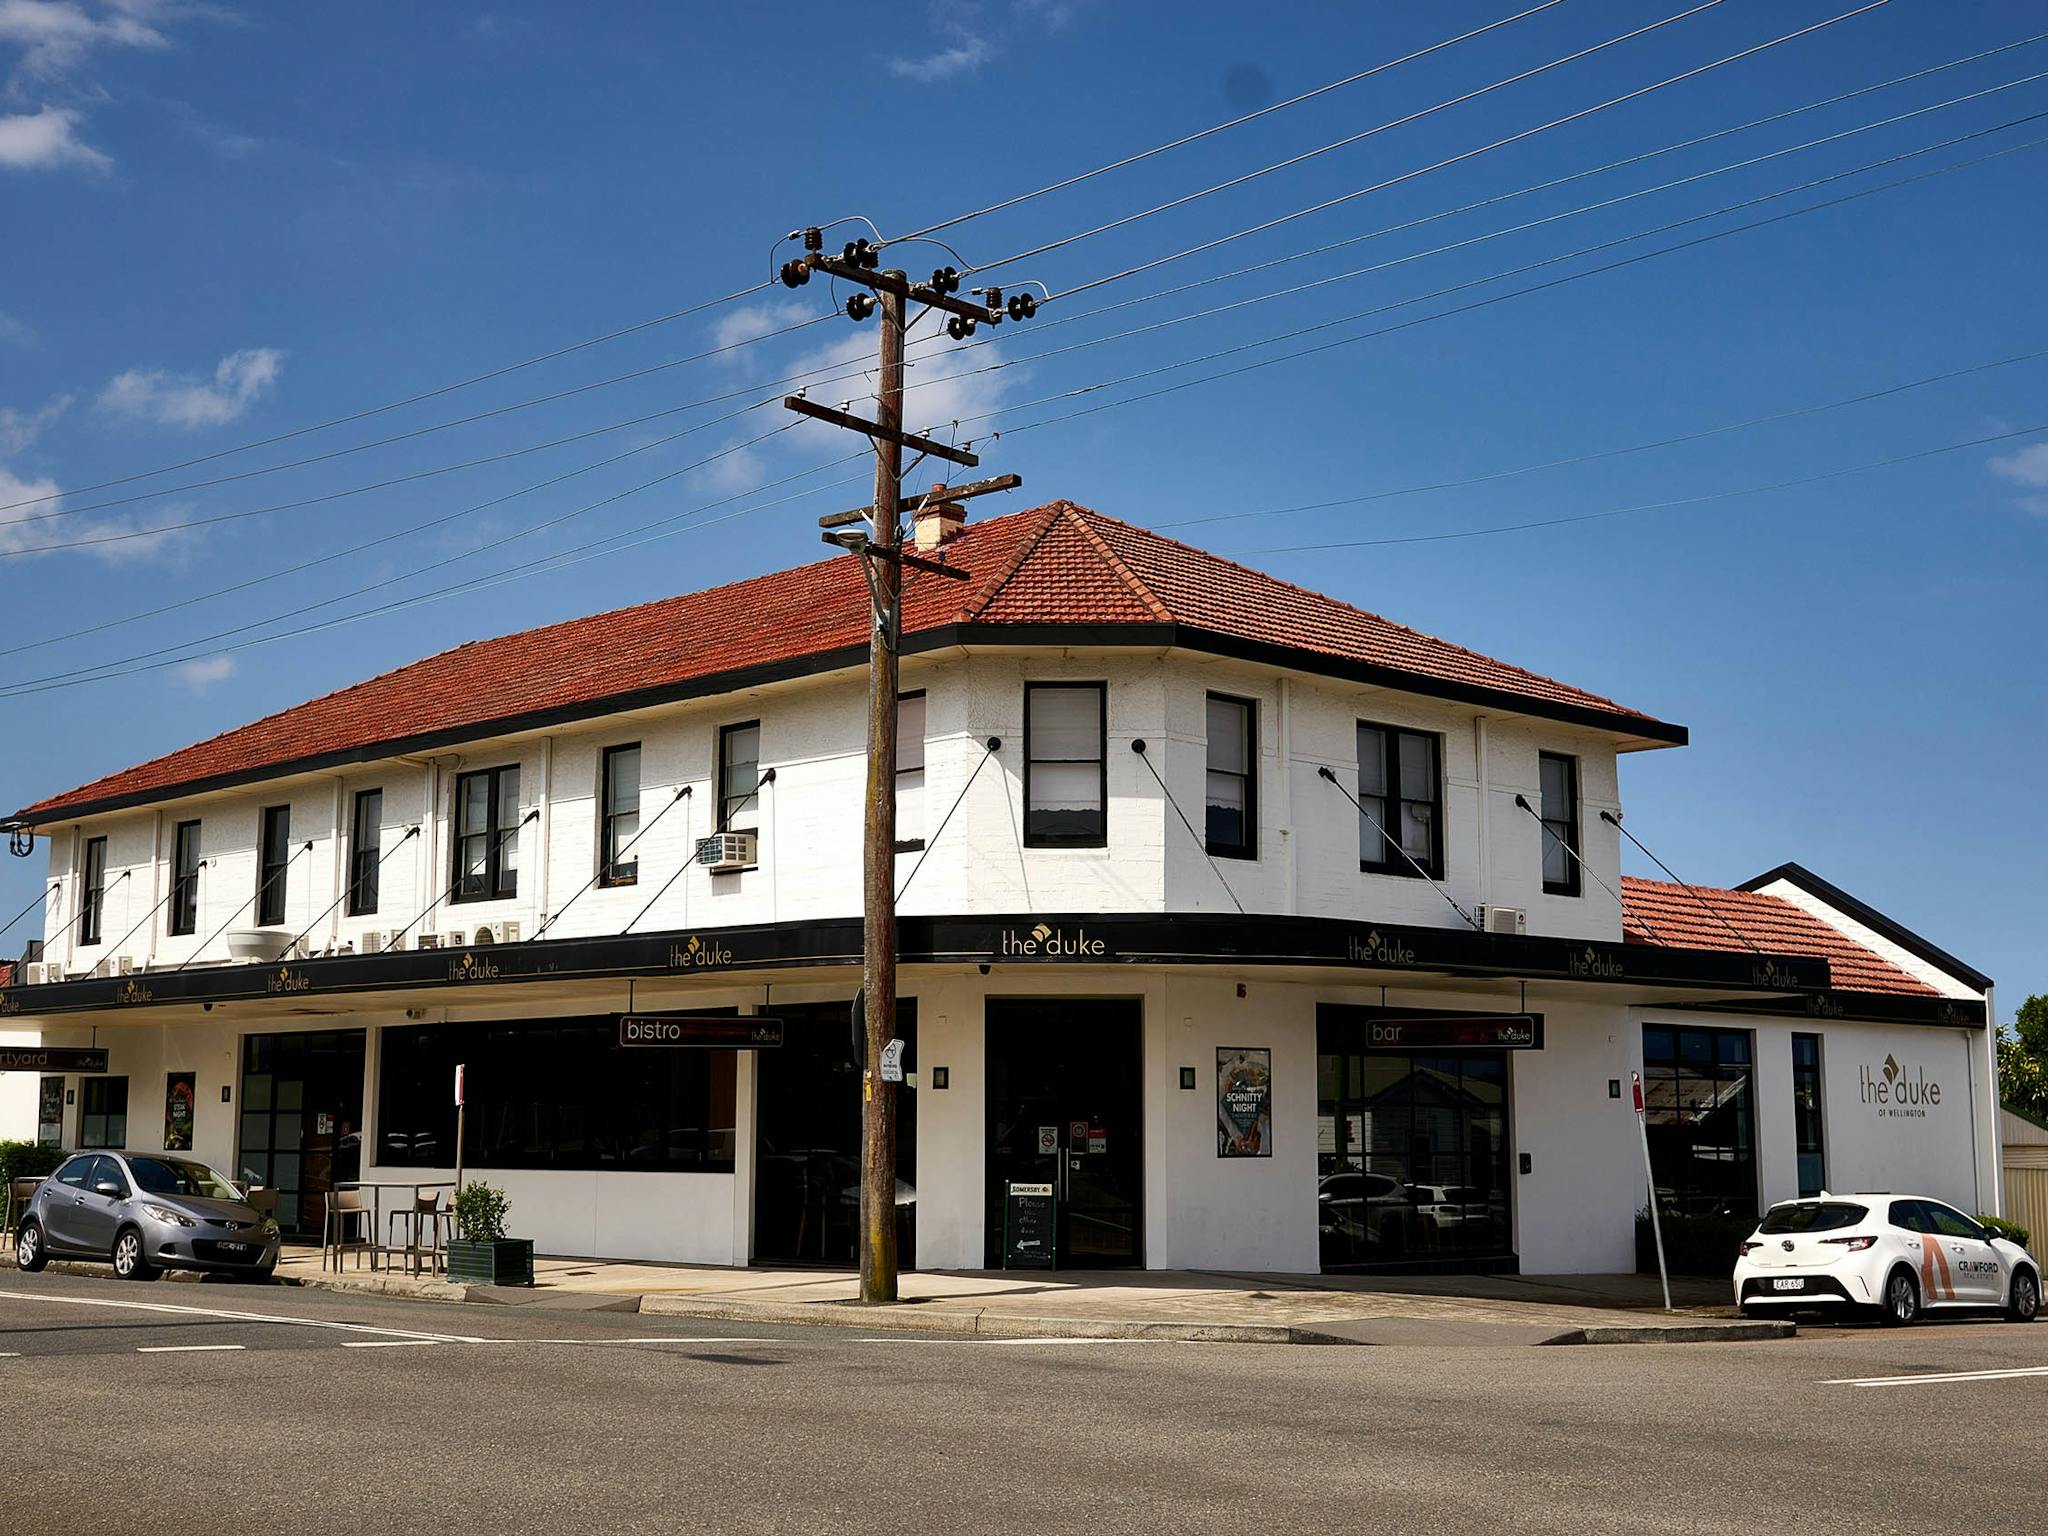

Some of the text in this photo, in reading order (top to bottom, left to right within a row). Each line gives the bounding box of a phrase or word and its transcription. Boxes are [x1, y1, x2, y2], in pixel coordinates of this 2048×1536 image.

[1003, 929, 1105, 955] the duke
[1349, 936, 1415, 964] the duke
[670, 941, 732, 967] the duke
[1569, 952, 1624, 977] the duke
[448, 956, 499, 980] the duke
[1752, 966, 1798, 988] the duke
[267, 970, 309, 993] the duke
[131, 983, 153, 1003] duke
[627, 1021, 681, 1040] bistro
[1372, 1024, 1402, 1041] bar
[1511, 1028, 1531, 1041] duke
[1860, 1064, 1941, 1105] the duke
[1226, 1092, 1262, 1102] SCHNITTY
[1232, 1103, 1257, 1113] NIGHT
[1878, 1109, 1926, 1118] OF WELLINGTON
[1958, 1260, 1999, 1273] CRAWFORD
